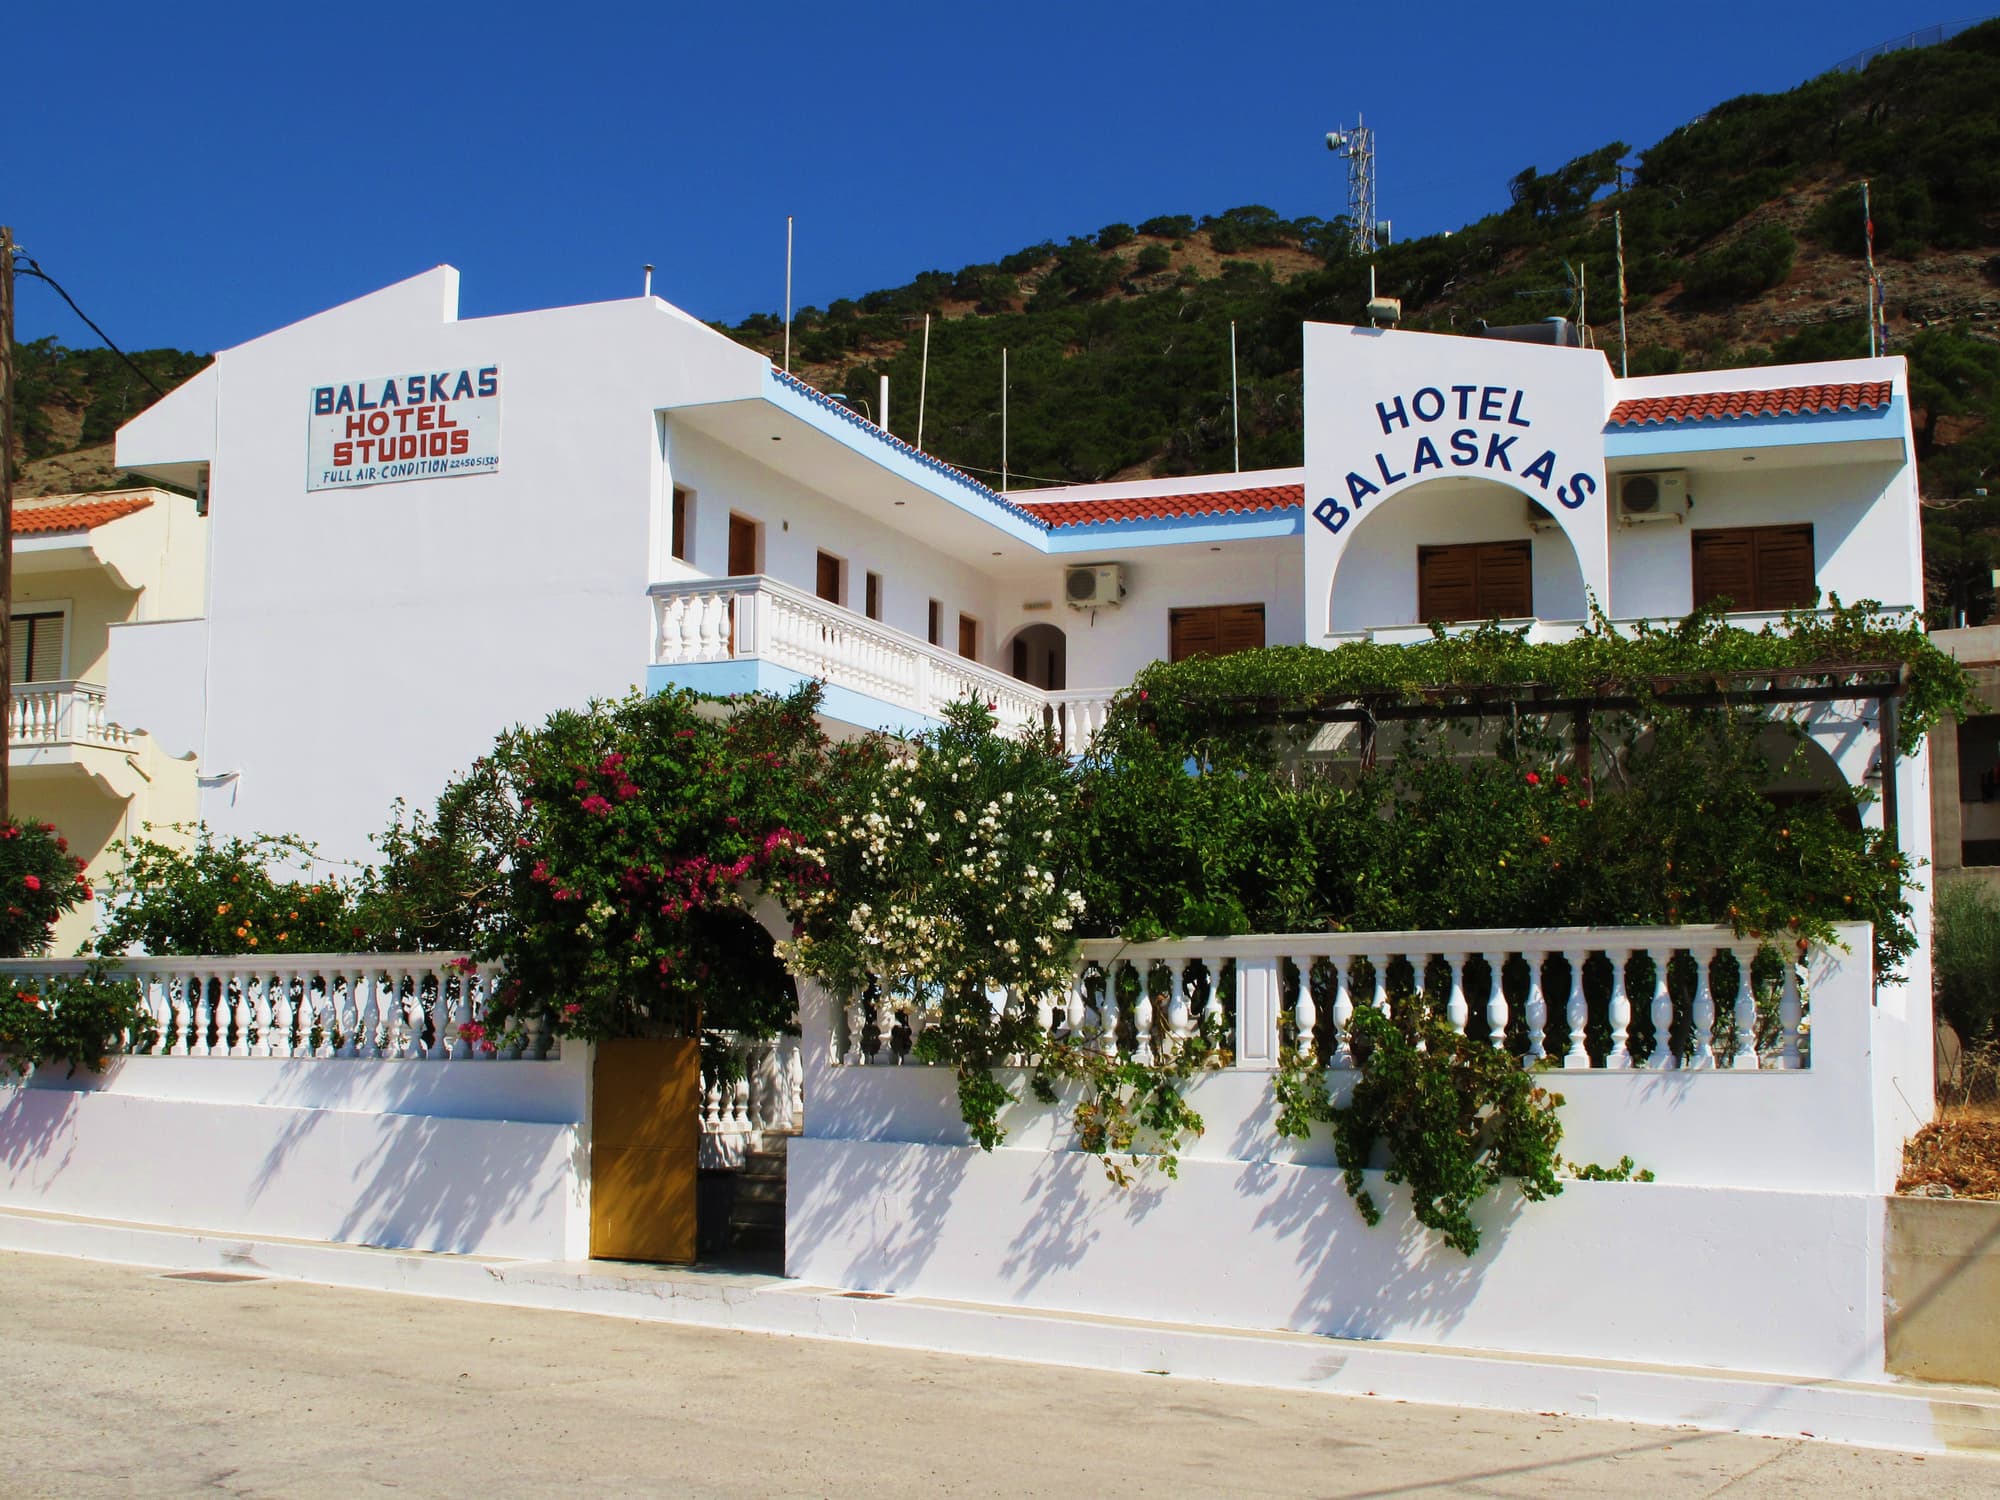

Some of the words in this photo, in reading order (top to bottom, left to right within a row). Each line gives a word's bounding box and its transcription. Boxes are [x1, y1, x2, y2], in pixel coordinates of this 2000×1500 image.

[315, 367, 498, 416] BALASKAS
[1375, 385, 1531, 435] HOTEL
[345, 404, 457, 439] HOTEL
[333, 429, 469, 466] STUDIOS
[323, 470, 353, 483] FULL
[1312, 429, 1597, 535] BALASKAS
